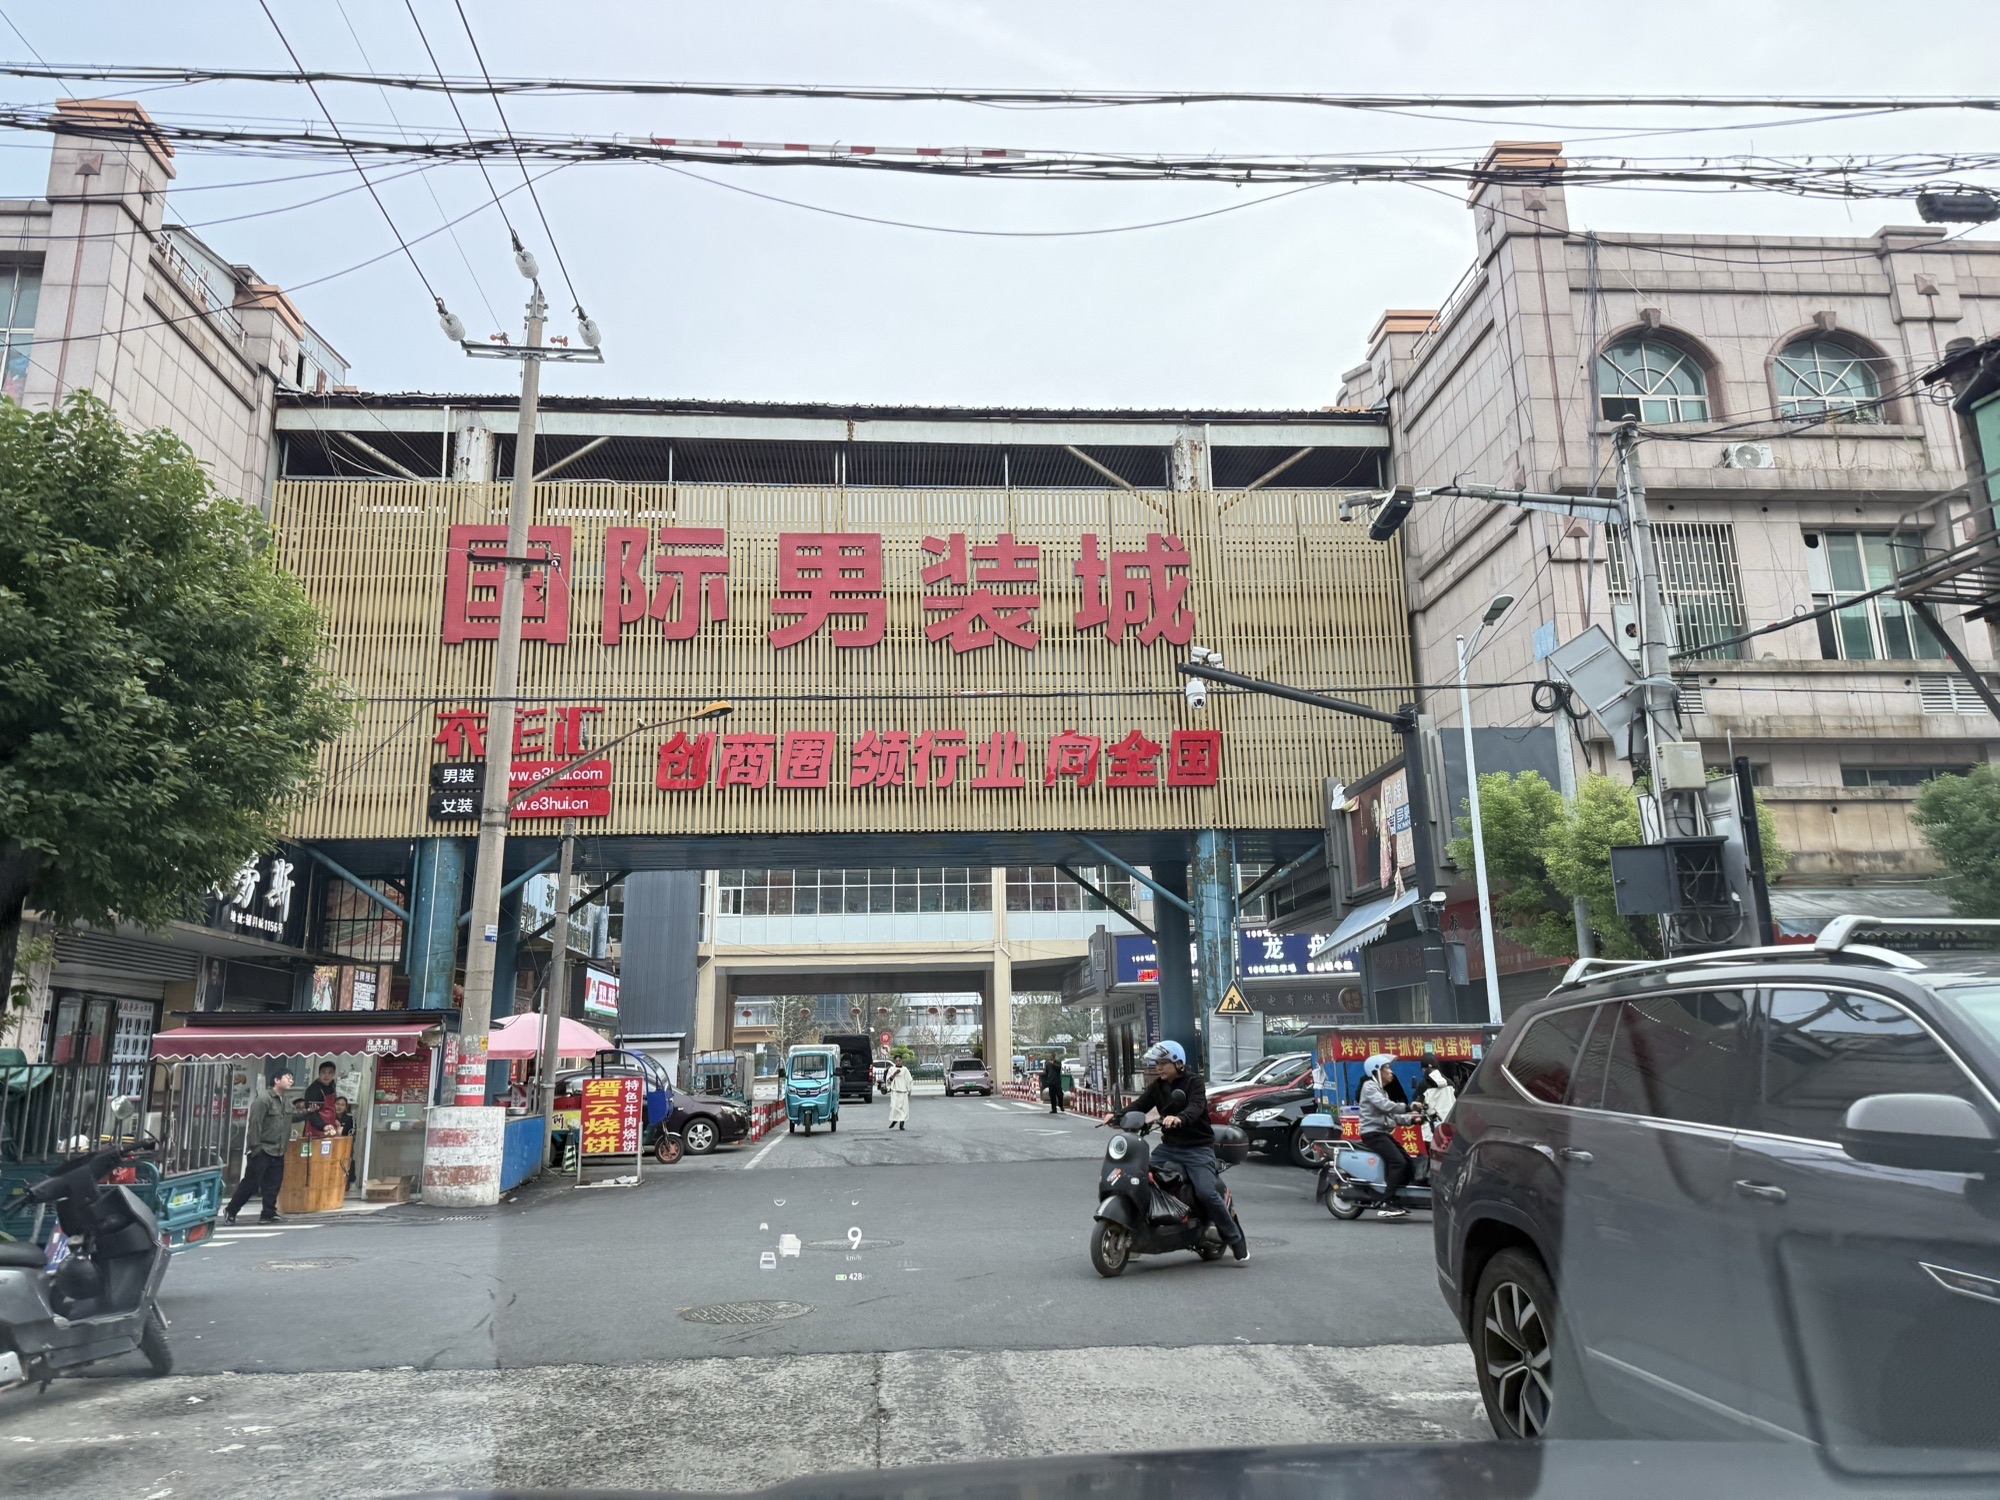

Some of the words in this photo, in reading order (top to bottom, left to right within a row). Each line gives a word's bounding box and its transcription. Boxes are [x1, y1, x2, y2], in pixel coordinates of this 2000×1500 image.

[443, 524, 1194, 652] 国际男装城
[442, 768, 475, 784] 男装
[441, 798, 473, 814] 女装
[511, 796, 589, 812] w.e3hui.cn
[1341, 1037, 1380, 1056] 烤冷面
[1384, 1036, 1424, 1056] 手抓饼
[1432, 1036, 1472, 1056] 鸡蛋饼
[583, 1079, 623, 1154] 缙云烧饼
[622, 1079, 640, 1152] 特色牛肉烧饼
[1401, 1124, 1420, 1154] 米线
[847, 1226, 863, 1250] 9
[846, 1254, 862, 1262] km/h
[848, 1272, 863, 1281] 428
